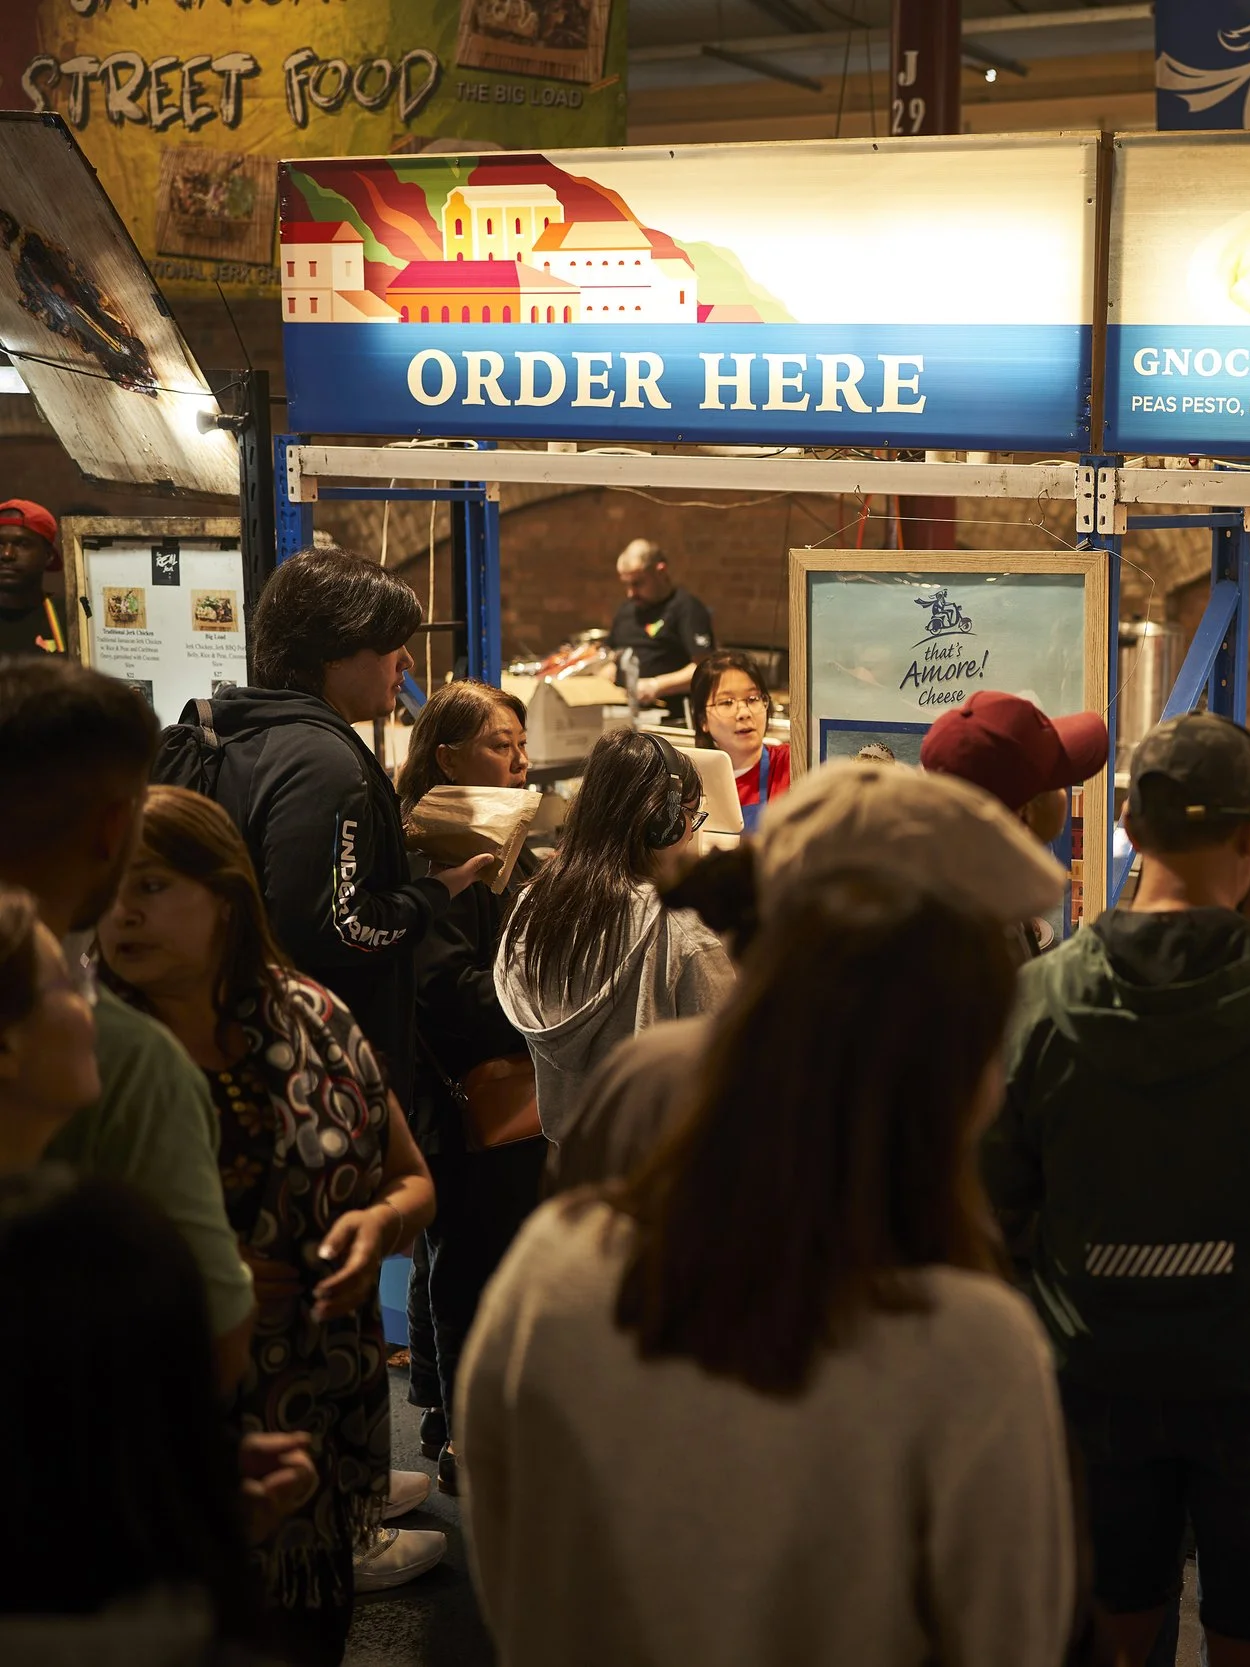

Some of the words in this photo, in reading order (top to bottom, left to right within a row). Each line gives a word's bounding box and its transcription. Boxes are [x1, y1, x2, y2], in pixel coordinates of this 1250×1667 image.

[898, 51, 919, 87] J
[21, 51, 256, 128] STREET
[284, 47, 441, 128] FOOD
[457, 82, 489, 103] THE
[496, 85, 525, 104] BIG
[531, 88, 583, 109] LOAD
[892, 98, 926, 135] 29
[406, 348, 672, 409] ORDER
[699, 351, 927, 414] HERE
[1132, 395, 1177, 413] PEAS
[1182, 396, 1245, 418] PESTO,
[924, 642, 963, 660] that's
[899, 649, 990, 690] Amore!
